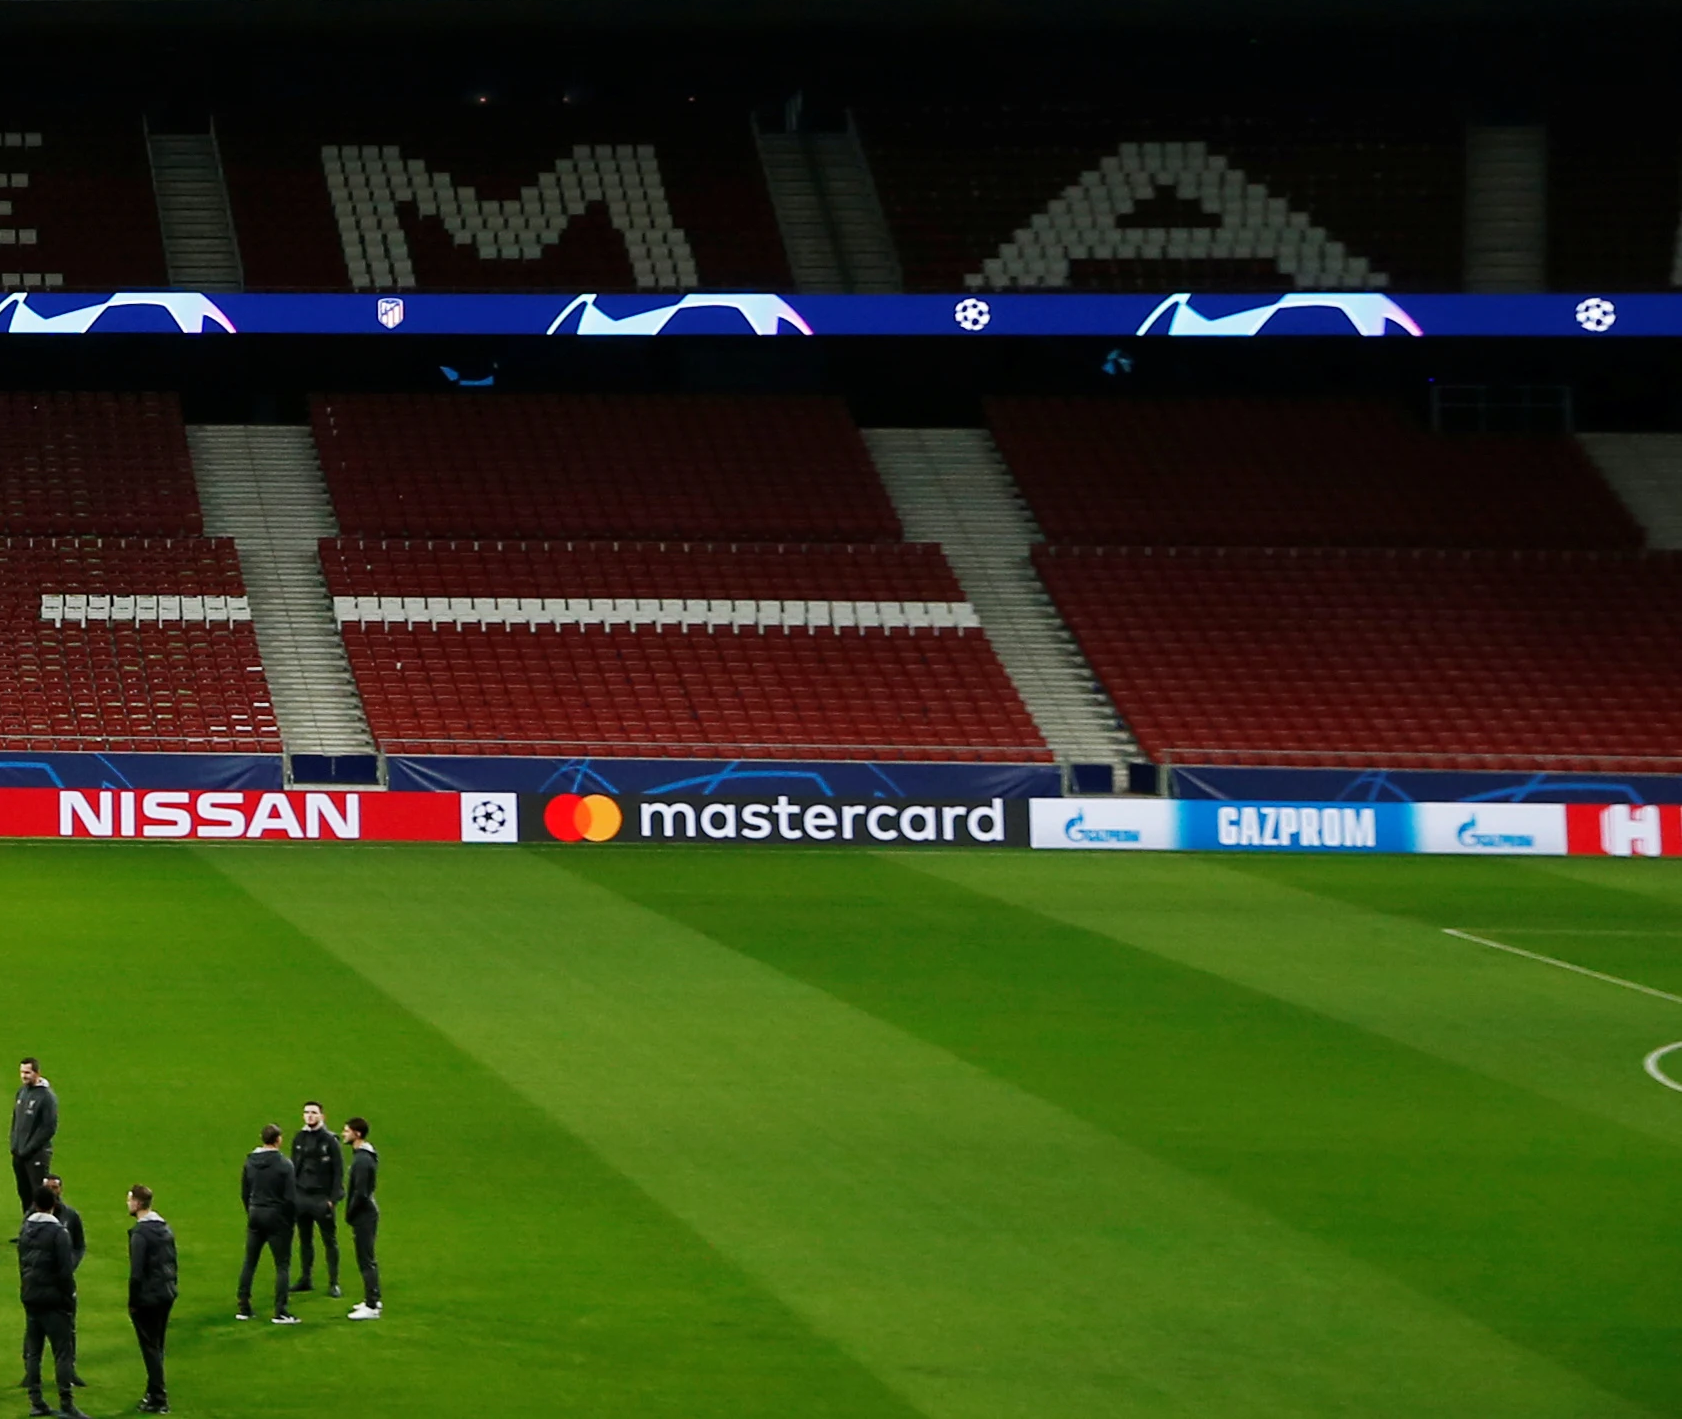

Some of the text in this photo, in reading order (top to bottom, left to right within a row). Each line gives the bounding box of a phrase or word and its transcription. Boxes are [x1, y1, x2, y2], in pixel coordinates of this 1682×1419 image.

[58, 790, 361, 839] NISSAN
[640, 795, 1004, 842] mastercard
[1217, 807, 1376, 848] GAZPROM
